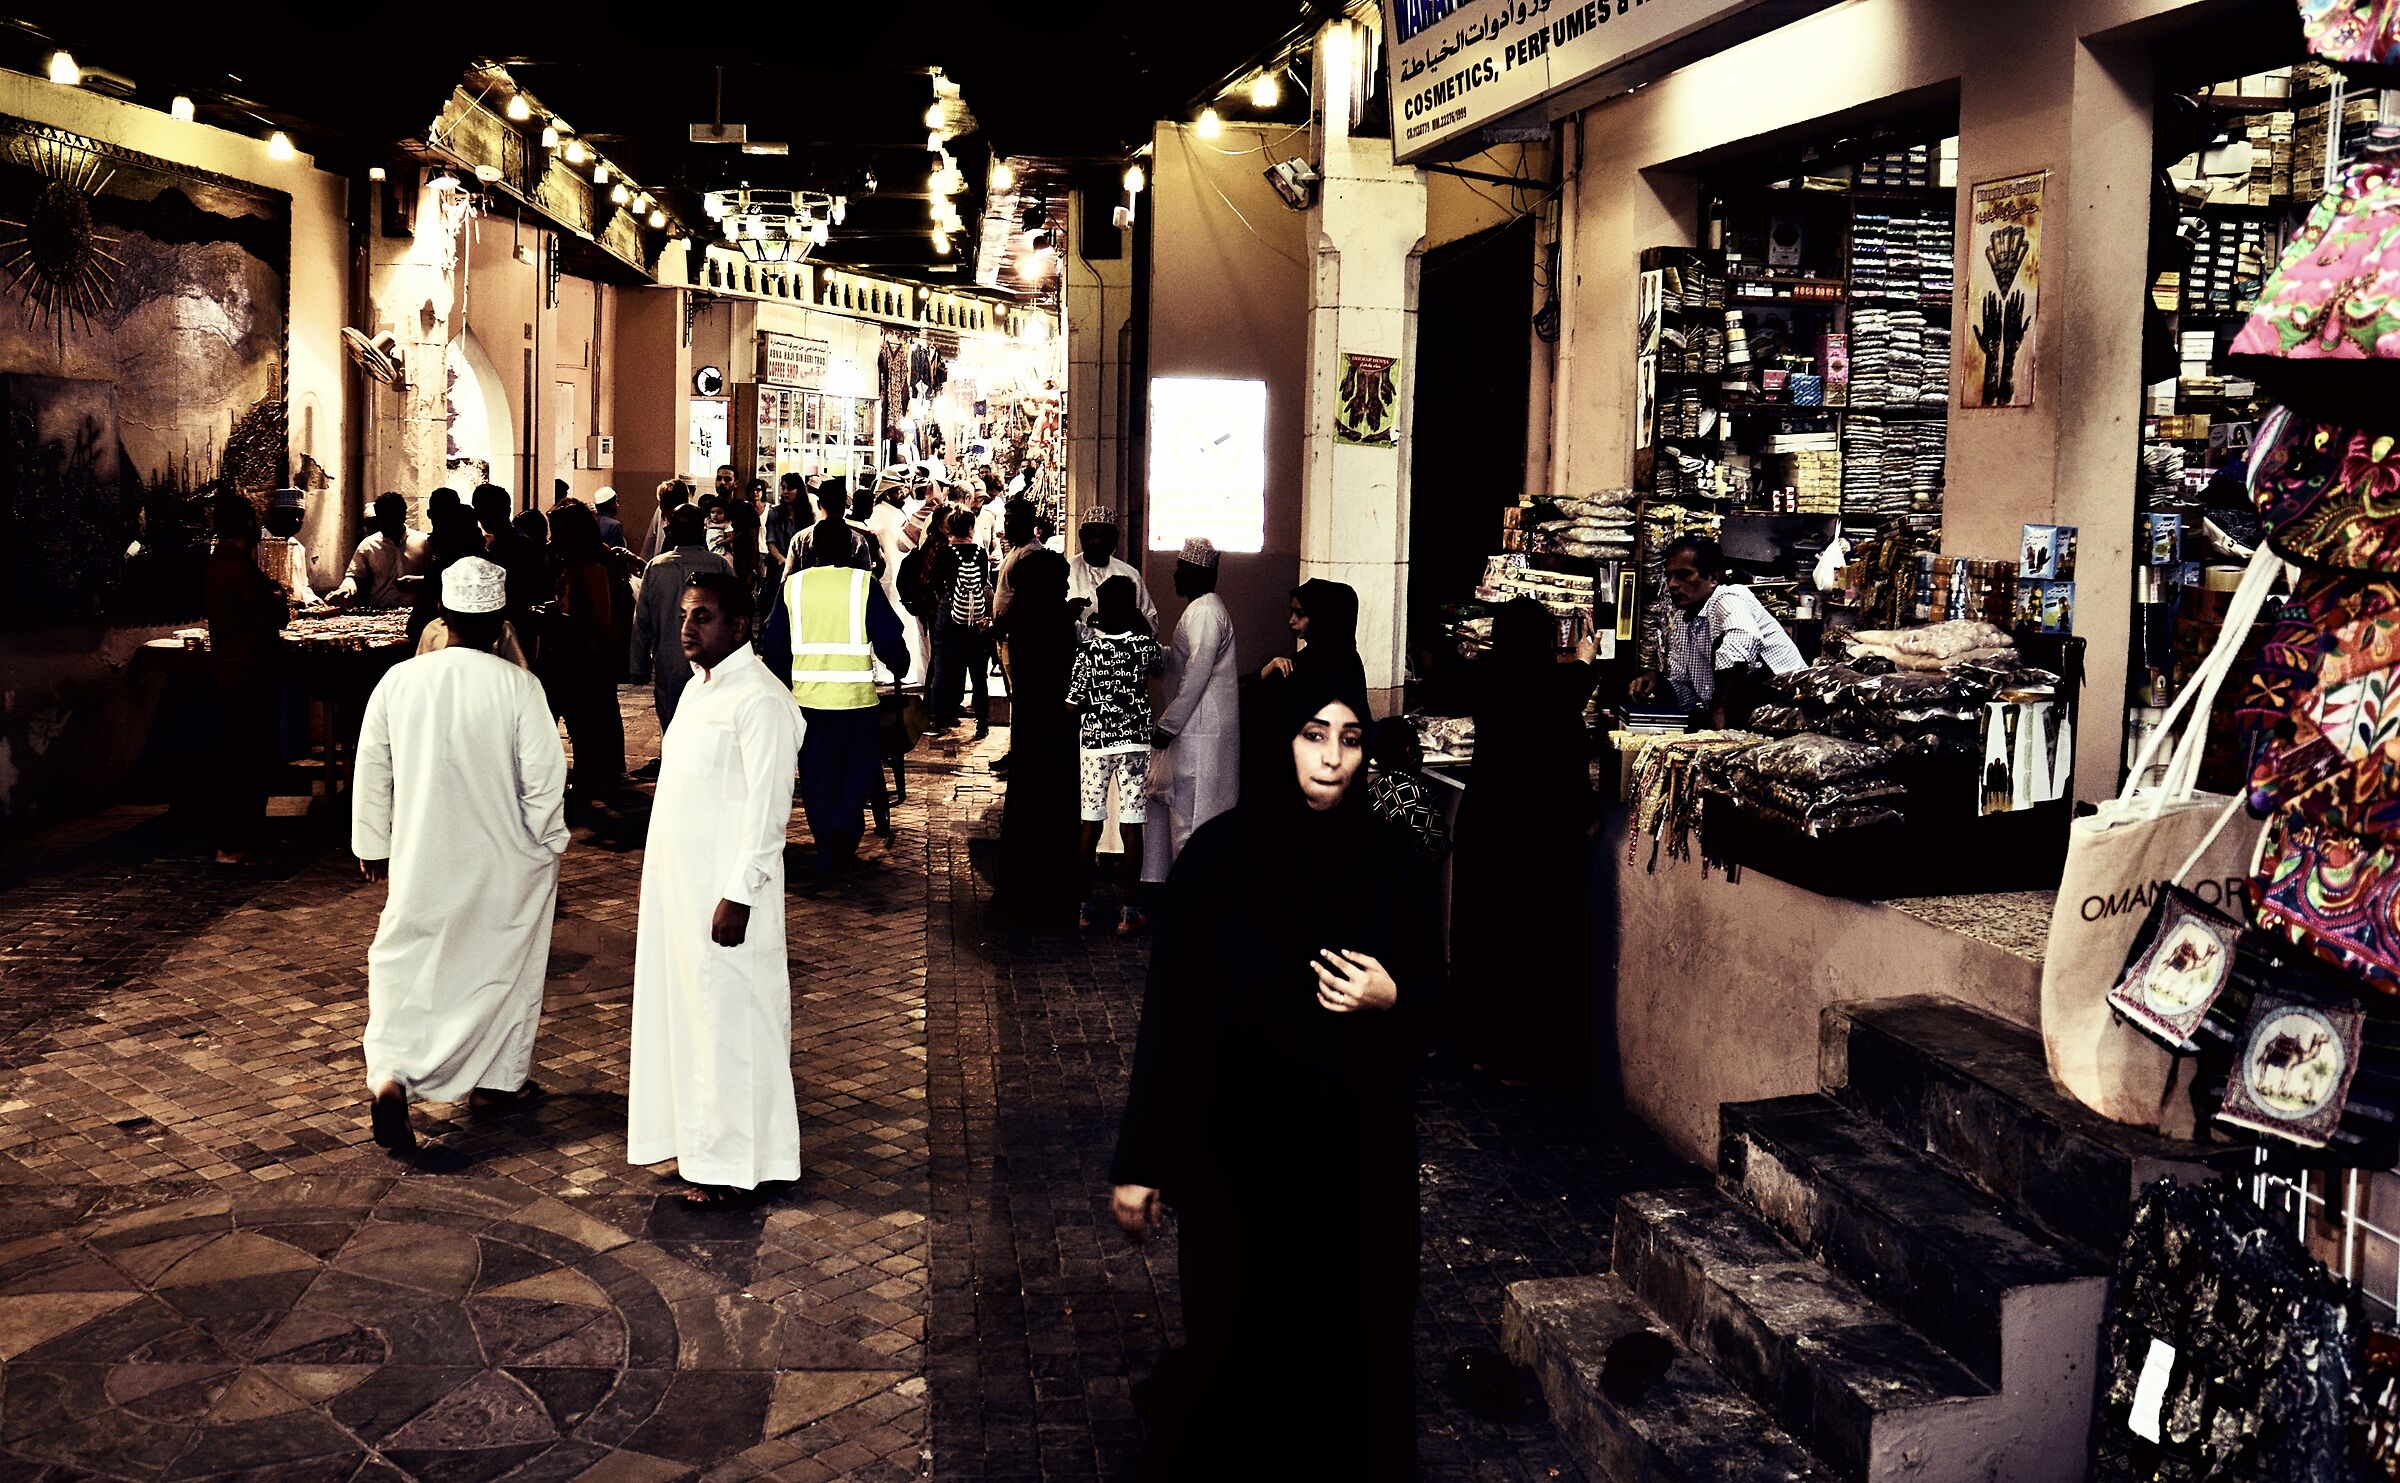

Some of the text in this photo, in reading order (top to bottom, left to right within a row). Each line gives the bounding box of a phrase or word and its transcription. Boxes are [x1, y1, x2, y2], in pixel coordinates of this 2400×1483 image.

[1404, 56, 1499, 121] COSMETICS,
[1505, 0, 1611, 72] PERFUMES
[768, 360, 798, 380] COFFEE SHOP
[1094, 653, 1126, 667] Mason
[1111, 666, 1132, 677] John
[1088, 689, 1113, 706] Luke
